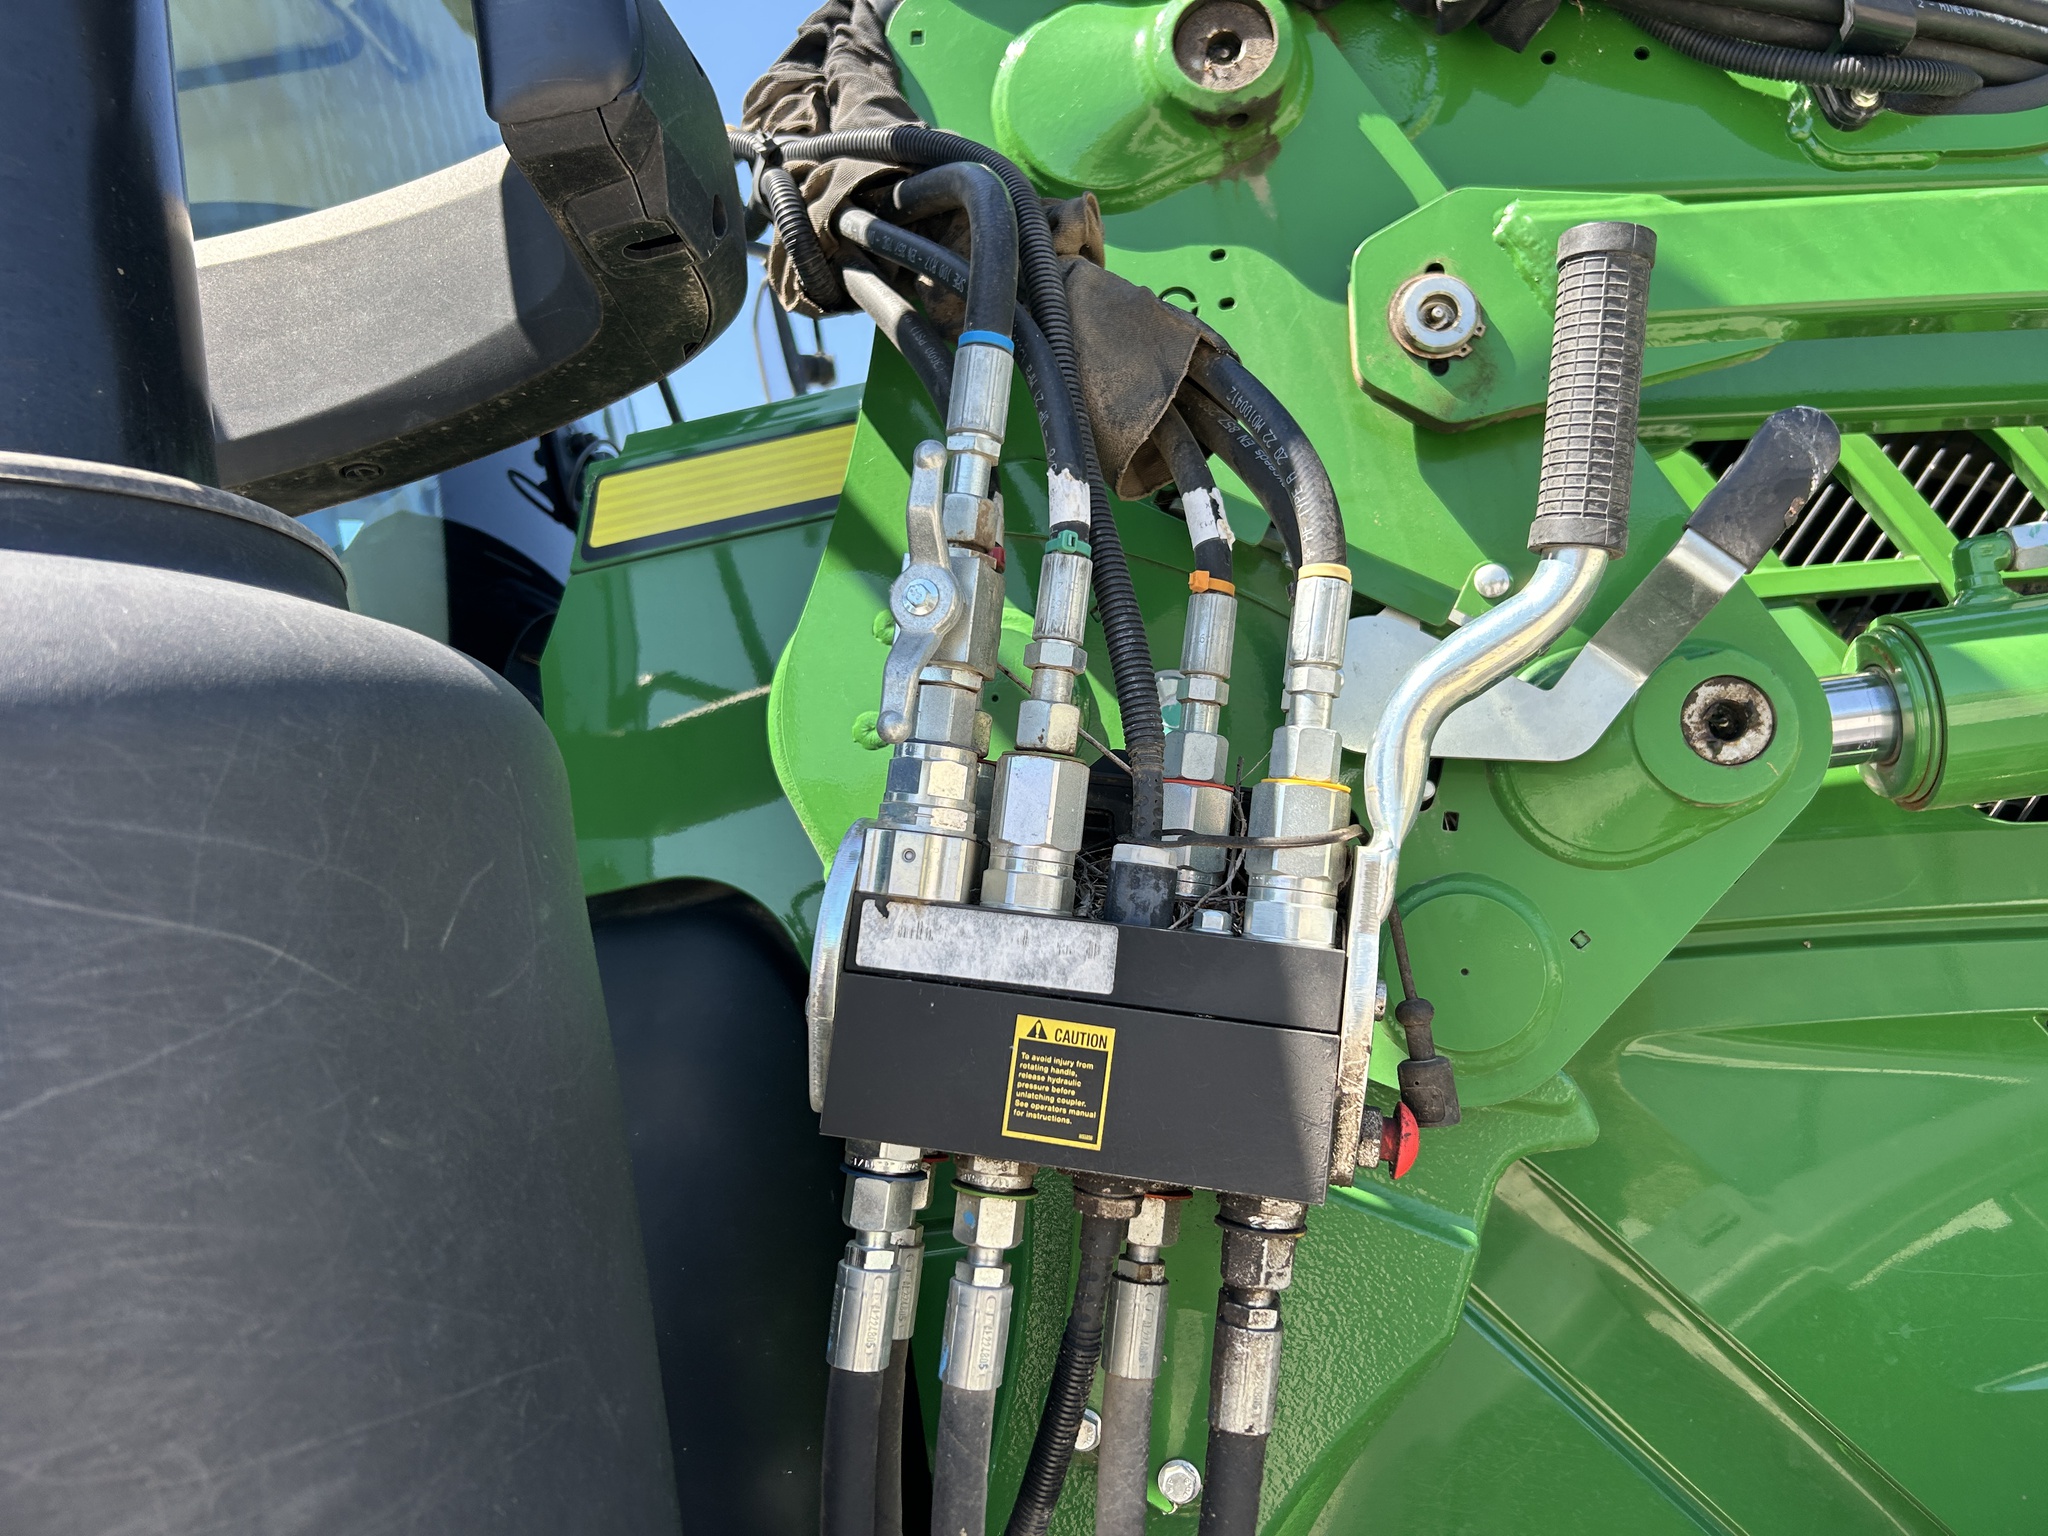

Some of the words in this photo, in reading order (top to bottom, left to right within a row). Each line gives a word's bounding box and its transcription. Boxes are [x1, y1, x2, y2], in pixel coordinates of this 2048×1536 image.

[1218, 418, 1241, 434] 857
[1237, 434, 1256, 449] EN
[1262, 429, 1278, 449] 22
[1285, 470, 1298, 485] A
[1291, 486, 1311, 517] TYPE
[1301, 526, 1314, 543] HF
[1054, 1028, 1108, 1049] CAUTION
[1021, 1051, 1030, 1061] To
[1031, 1054, 1052, 1064] avoid
[1053, 1057, 1075, 1068] injury
[1076, 1060, 1094, 1070] from
[1019, 1062, 1049, 1074] rotating
[1050, 1066, 1078, 1078] handle,
[1018, 1072, 1046, 1082] release
[1047, 1075, 1082, 1087] hydraulic
[1016, 1081, 1050, 1092] pressure
[1051, 1085, 1076, 1096] before
[1015, 1090, 1055, 1104] unlatching
[1056, 1097, 1087, 1108] coupler.
[1013, 1109, 1025, 1117] for
[1025, 1110, 1073, 1125] instructions.
[1014, 1099, 1029, 1108] See
[1030, 1103, 1067, 1115] operators
[1068, 1108, 1097, 1119] manual
